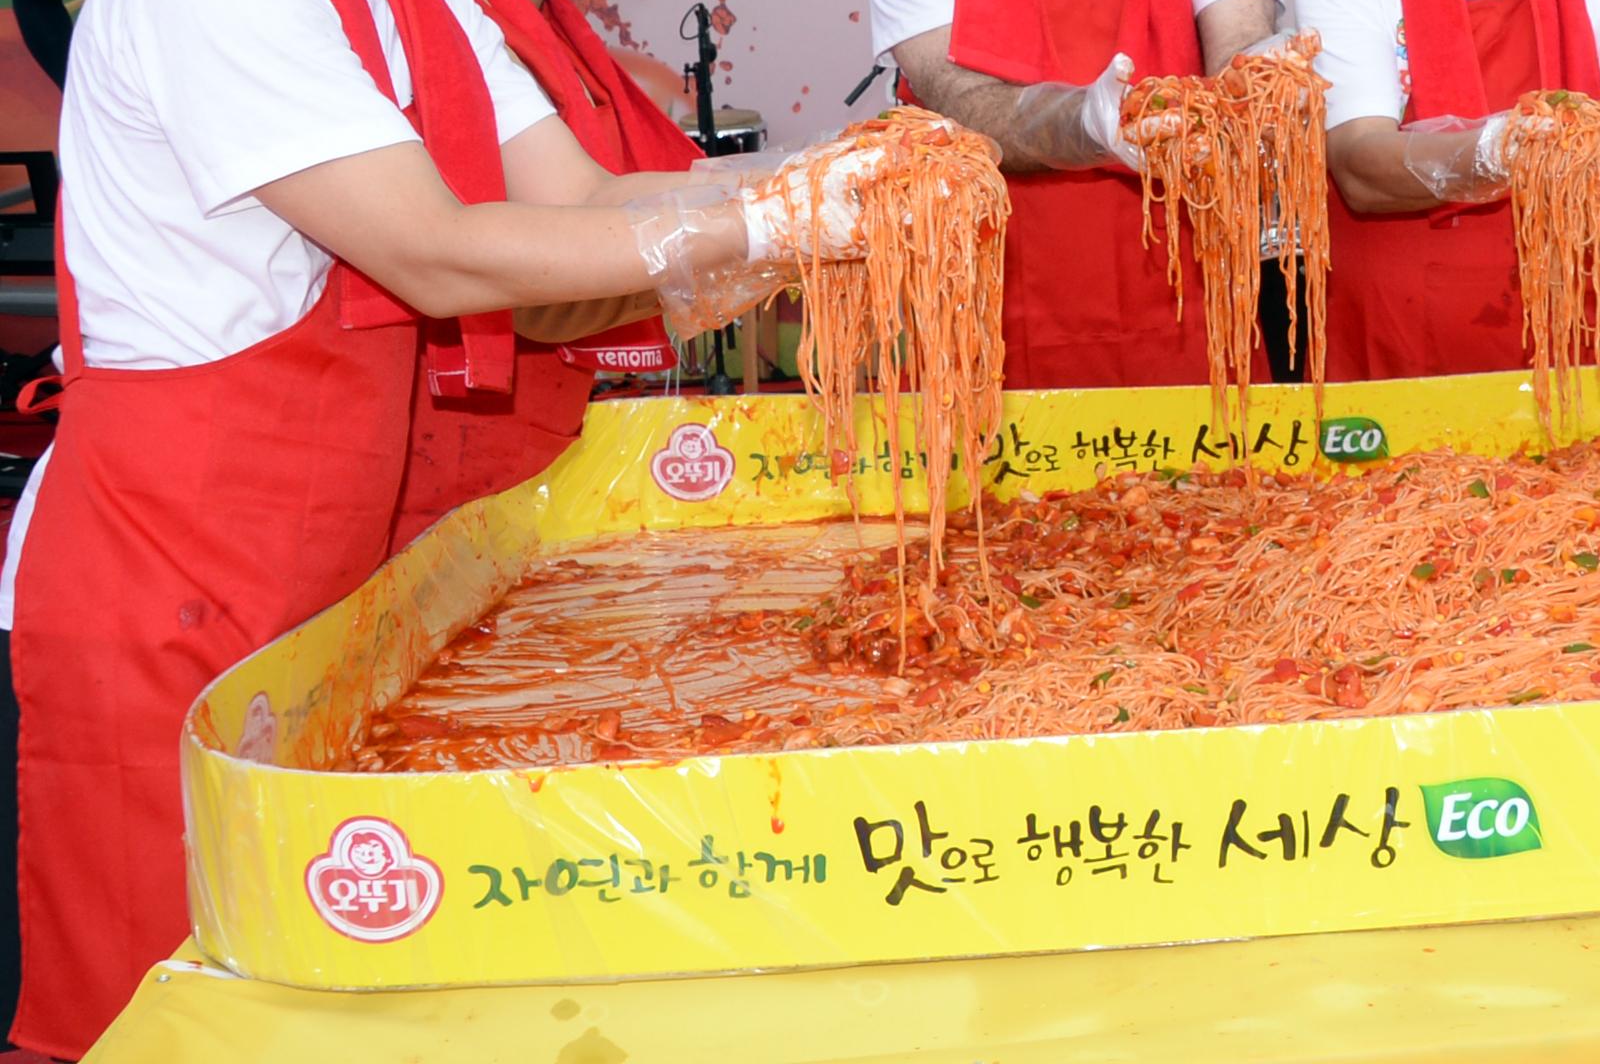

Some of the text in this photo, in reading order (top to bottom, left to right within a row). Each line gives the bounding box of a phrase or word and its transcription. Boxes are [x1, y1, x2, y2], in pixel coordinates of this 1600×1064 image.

[596, 349, 663, 368] renoma
[1071, 426, 1176, 473] 행복한
[1190, 419, 1309, 468] 세상
[665, 461, 721, 484] 오뚜기
[467, 786, 1412, 911] 자연과 함께 맛으로 행복한 세상
[328, 877, 420, 914] 오뚜기
